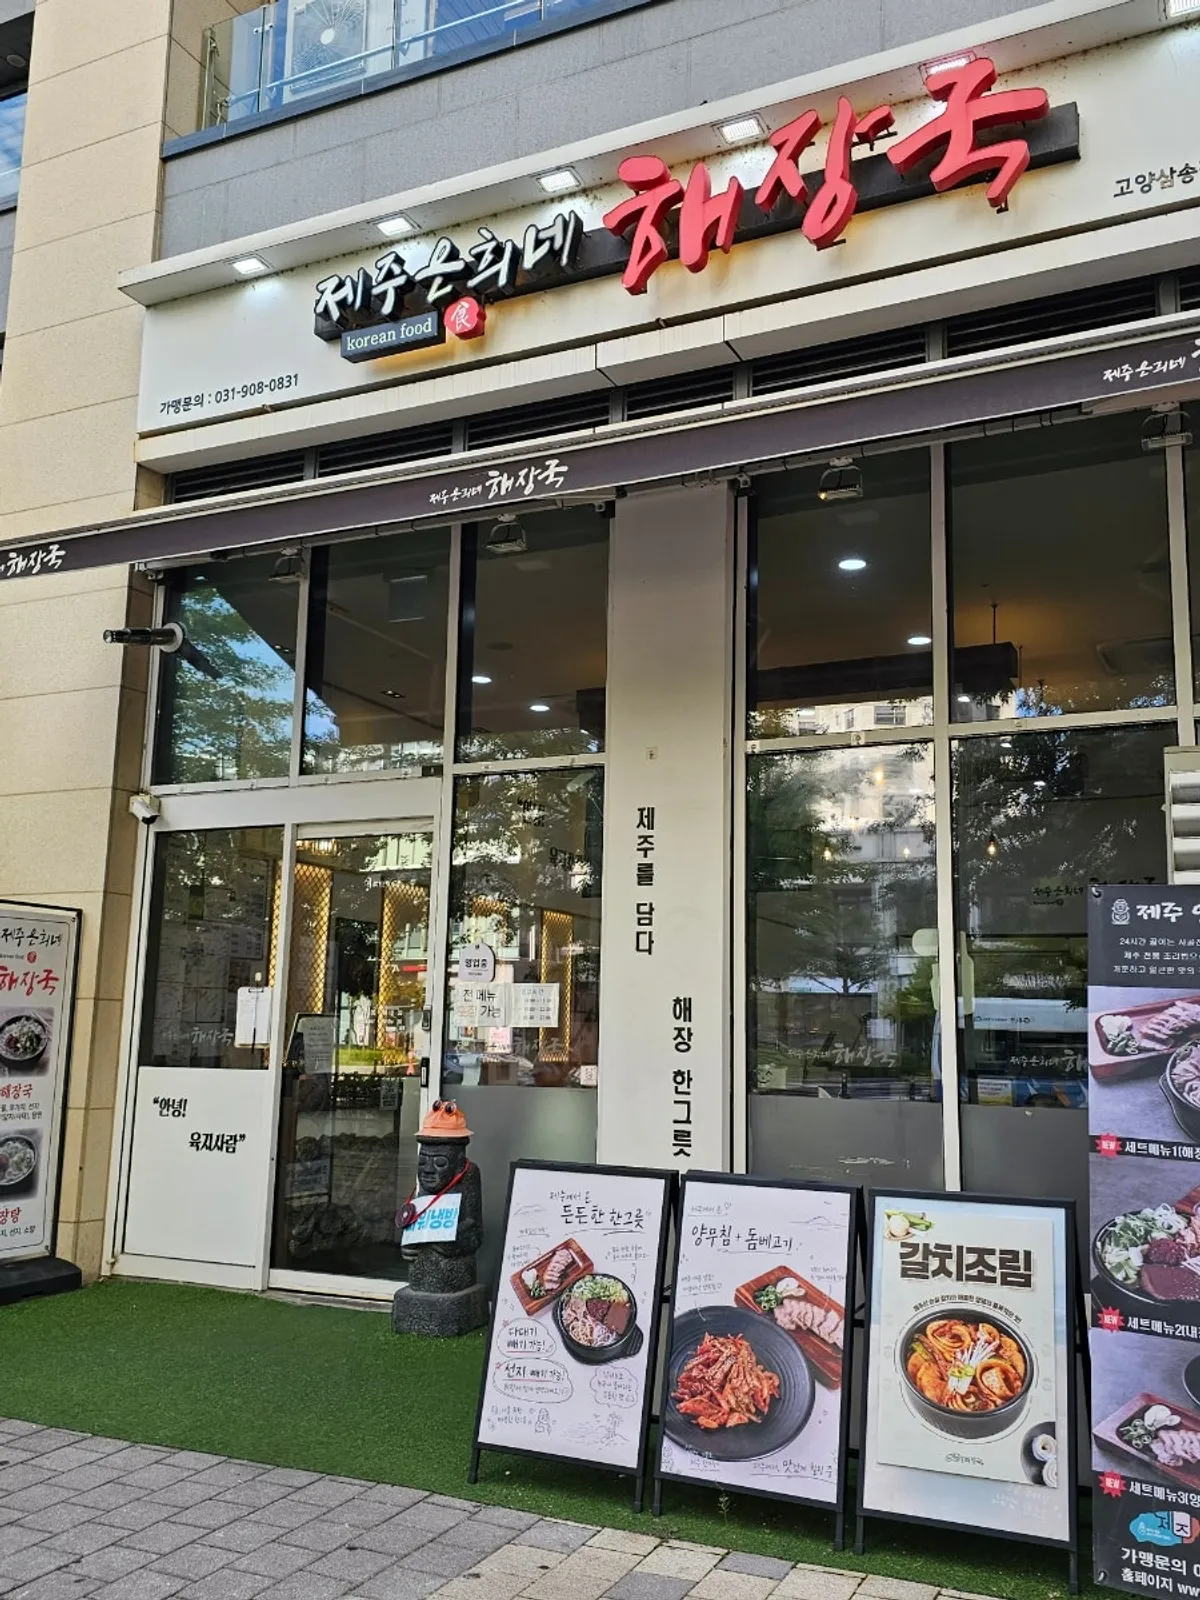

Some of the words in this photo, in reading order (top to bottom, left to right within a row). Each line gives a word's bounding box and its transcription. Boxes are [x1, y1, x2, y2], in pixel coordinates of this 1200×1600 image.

[314, 209, 580, 323] 제주은희네
[602, 58, 1049, 295] 해장국
[1113, 163, 1200, 198] 고양삼송
[450, 302, 472, 332] 食
[347, 328, 396, 351] korean
[400, 318, 432, 341] food
[160, 392, 204, 415] 가맹문의
[215, 373, 299, 403] 031-908-0831
[486, 459, 568, 499] 해장국
[7, 544, 66, 577] 해장국
[635, 806, 655, 887] 제주를
[1136, 902, 1183, 923] 제주
[635, 902, 655, 956] 담다
[464, 958, 488, 969] 영업중
[1162, 952, 1200, 960] 조리법으
[0, 965, 60, 996] 해장국
[476, 989, 497, 1002] 메뉴
[480, 1005, 501, 1019] 가능
[672, 996, 693, 1054] 해장
[832, 1043, 898, 1068] 해장국
[672, 1069, 693, 1158] 한그릇
[1102, 1140, 1116, 1150] NEW
[405, 1207, 458, 1231] 워냉방
[560, 1204, 605, 1224] 든든한
[609, 1208, 644, 1229] 한그릇
[691, 1223, 732, 1248] 양무침
[745, 1227, 793, 1251] 돔베고기
[899, 1241, 1032, 1288] 갈치조림
[508, 1327, 538, 1337] 다대기
[1104, 1315, 1118, 1325] NEW
[1127, 1317, 1200, 1339] 세트메뉴2(내
[505, 1362, 527, 1378] 선지
[1105, 1477, 1120, 1489] NEW
[1121, 1547, 1187, 1576] 가맹문의
[1121, 1567, 1173, 1592] 홈페이지
